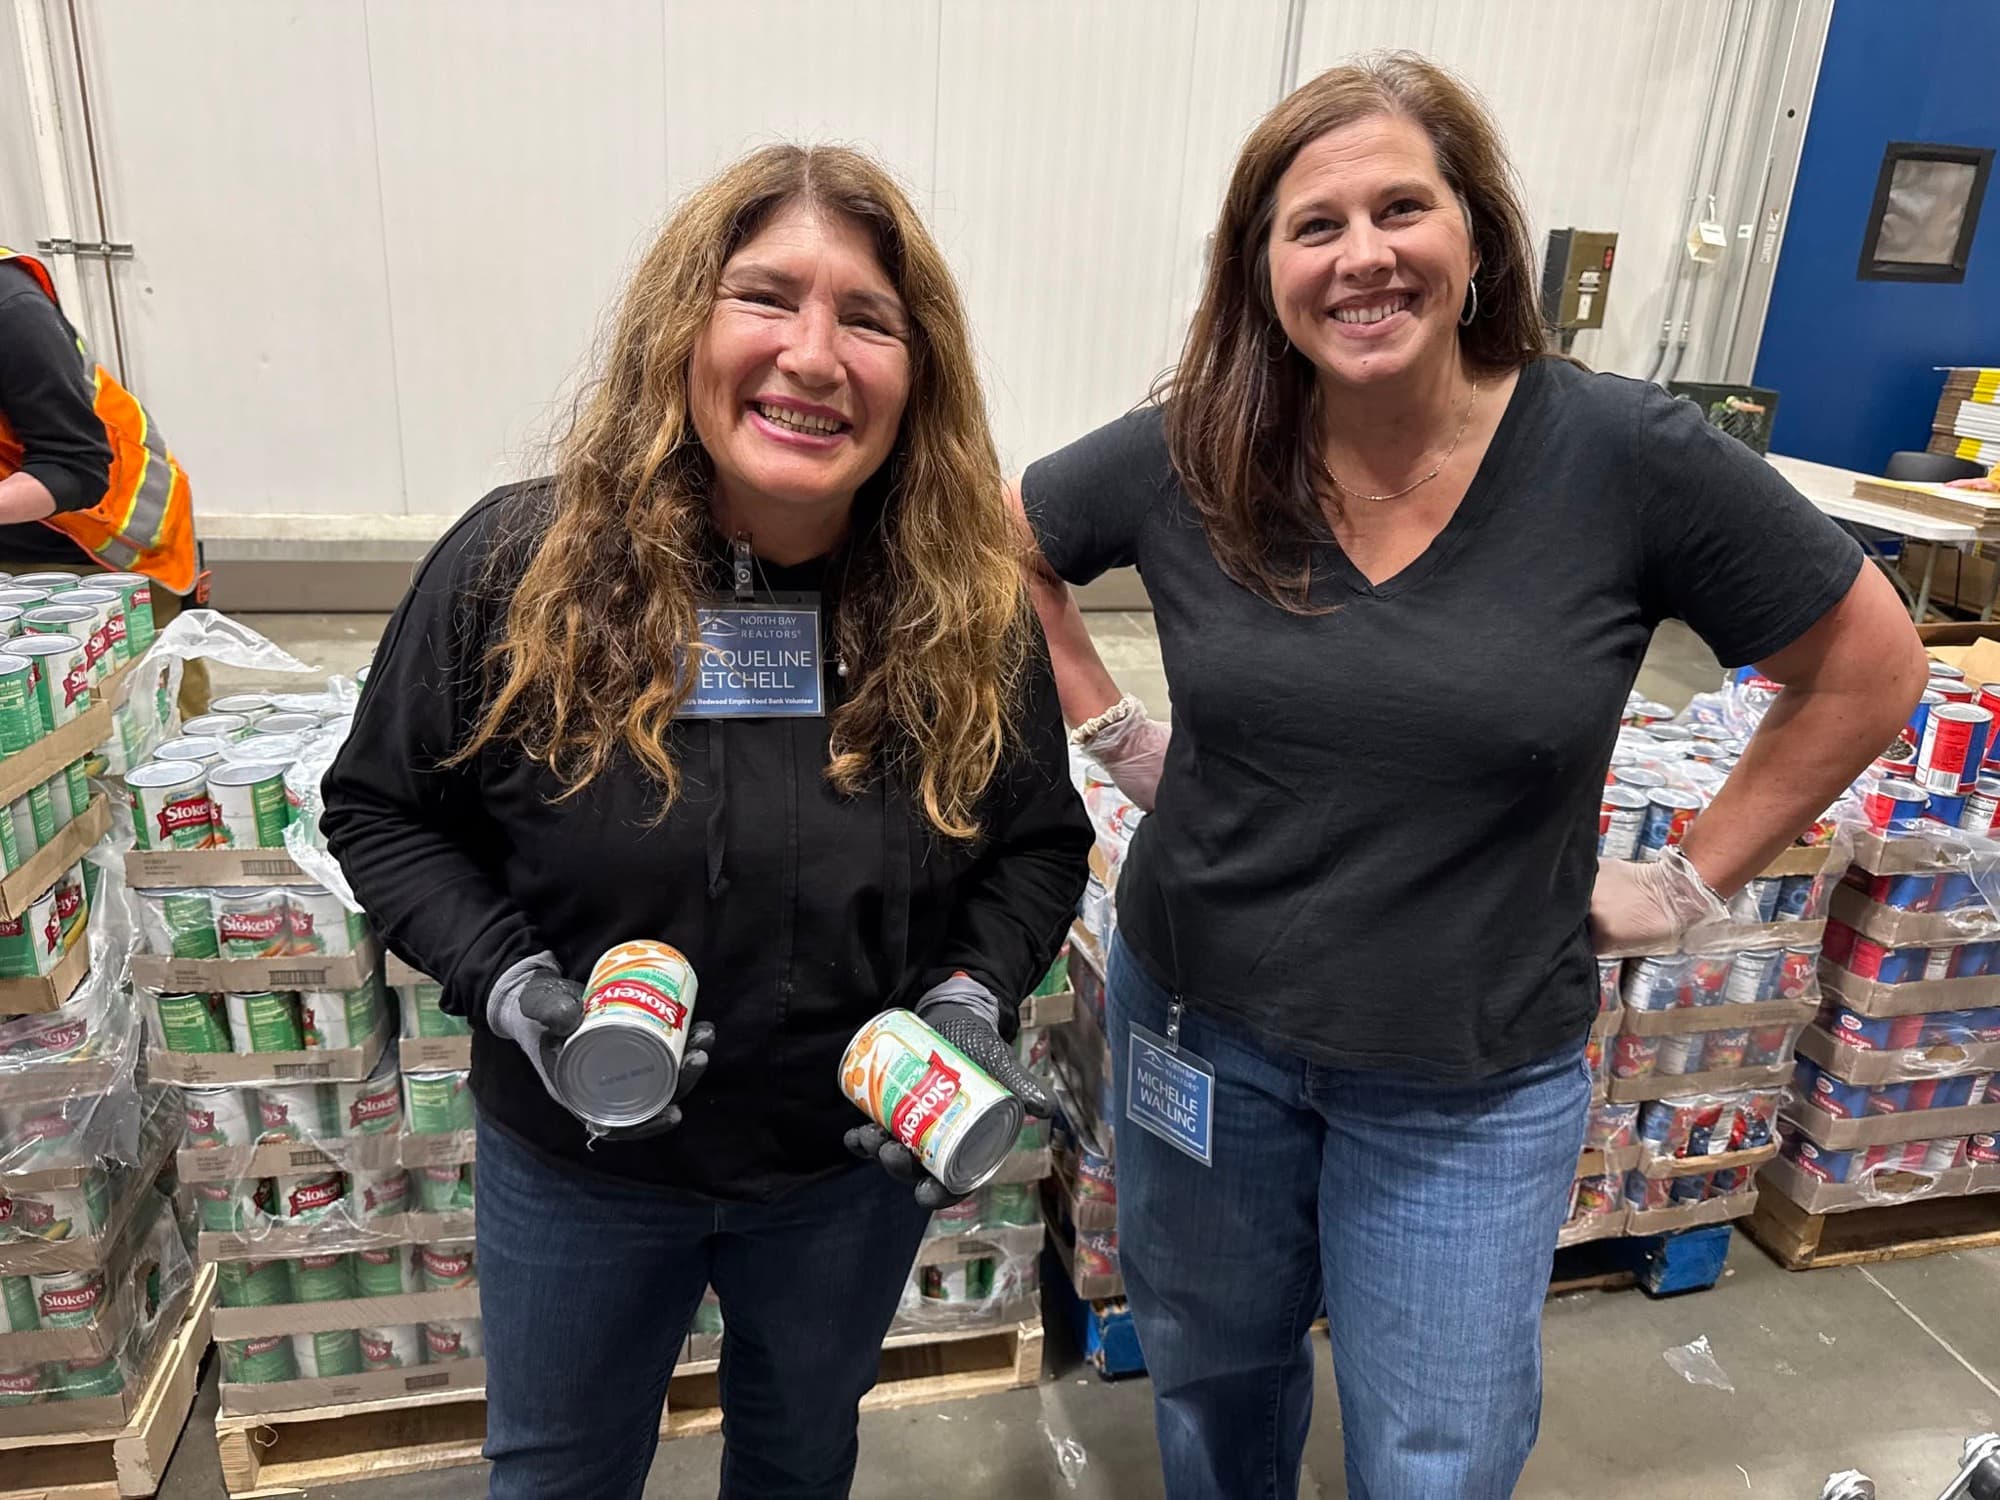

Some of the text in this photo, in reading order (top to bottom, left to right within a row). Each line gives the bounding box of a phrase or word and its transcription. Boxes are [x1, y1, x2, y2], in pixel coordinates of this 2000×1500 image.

[741, 616, 797, 625] NORTH BAY
[681, 650, 812, 667] JCQUELINE
[166, 801, 209, 823] Stoke
[1137, 1066, 1198, 1117] MICHELLE
[1140, 1086, 1196, 1133] WALLING
